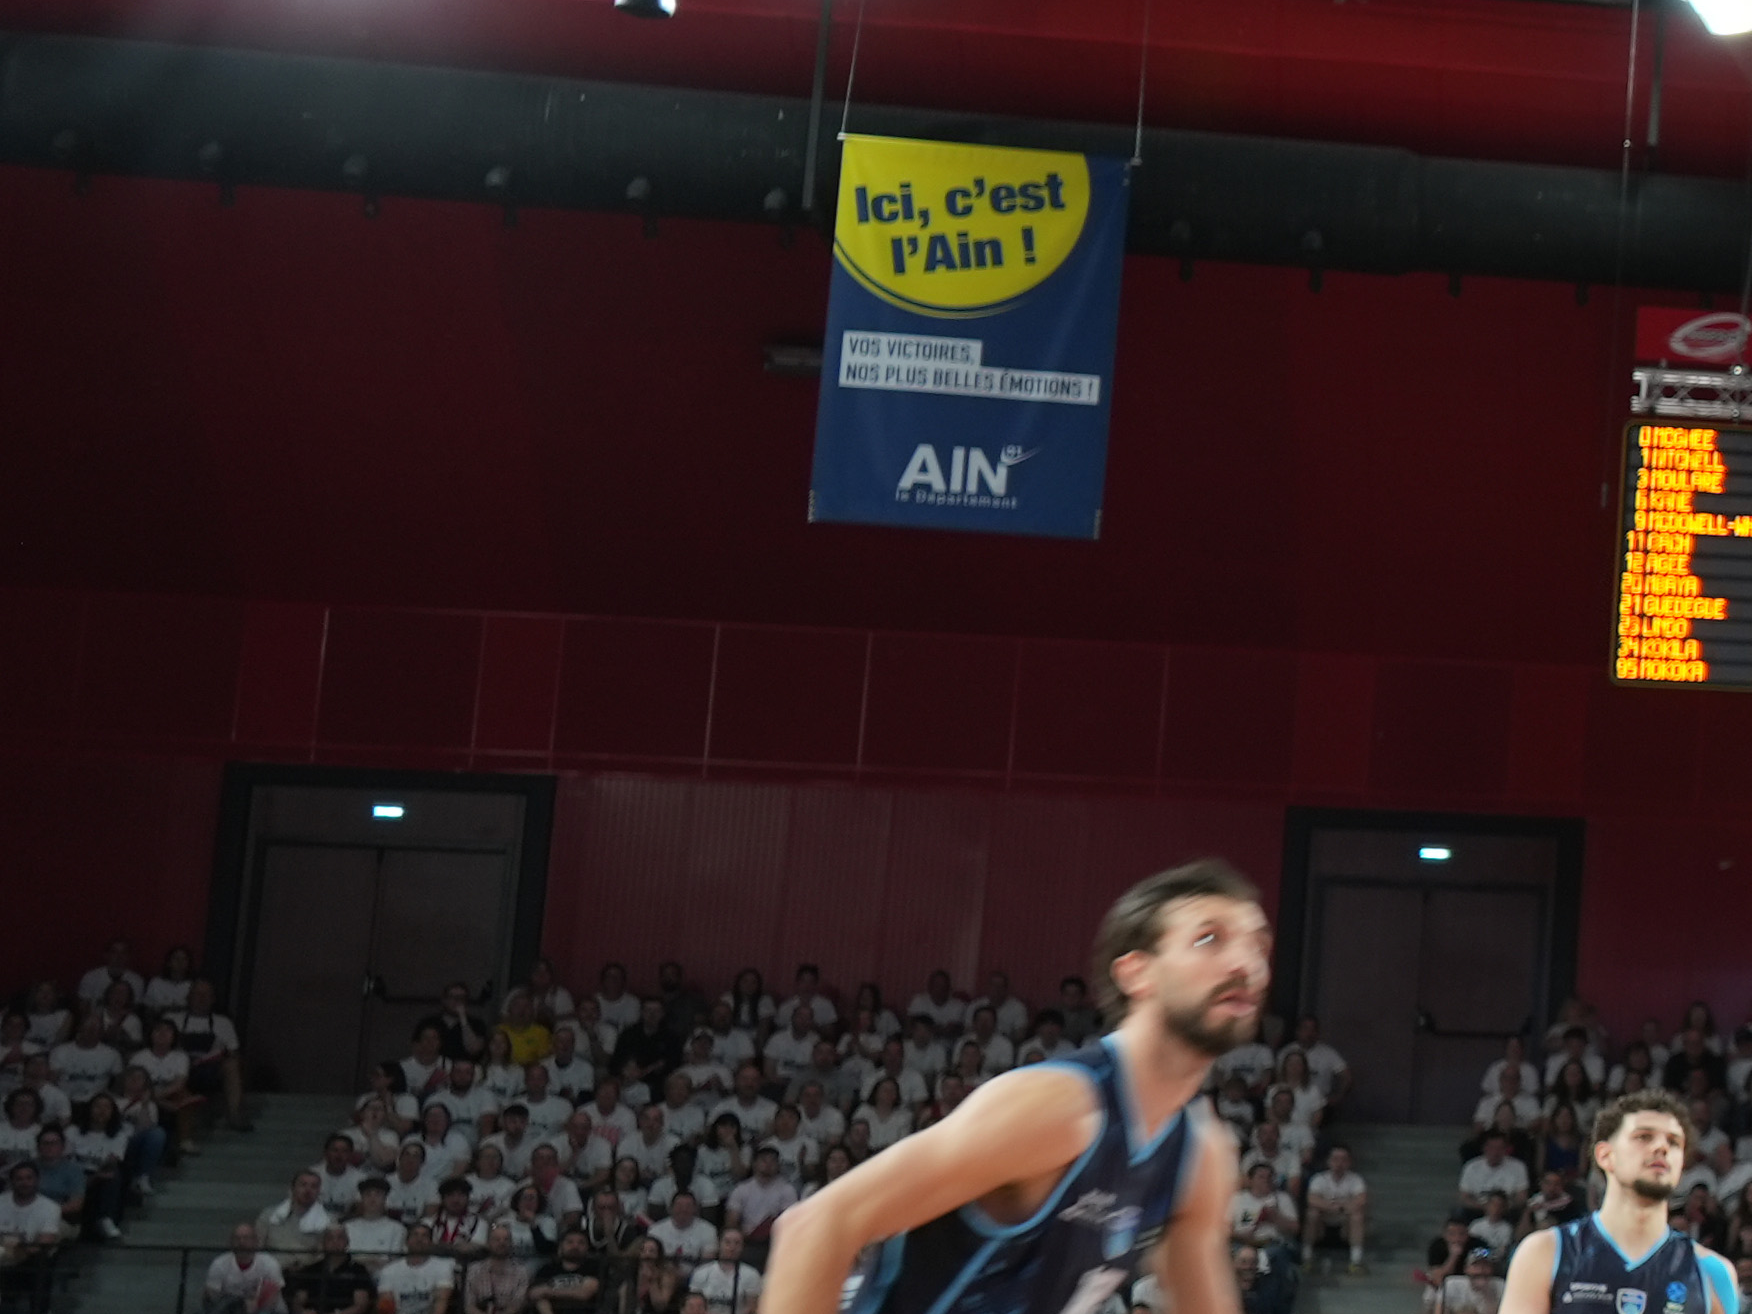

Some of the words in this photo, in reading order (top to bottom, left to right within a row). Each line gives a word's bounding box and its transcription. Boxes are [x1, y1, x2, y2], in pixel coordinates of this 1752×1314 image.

[854, 183, 930, 230] Ici,
[848, 334, 882, 359] VOS
[886, 337, 975, 364] VICTOIRES,
[845, 363, 880, 384] NOS
[885, 364, 927, 386] PLUS
[933, 367, 995, 393] BELLES
[999, 370, 1084, 400] ÉMOTIONS
[1639, 426, 1651, 447] 0
[896, 443, 1010, 497] AIN
[1626, 530, 1646, 551] 11
[1621, 572, 1644, 594] 20
[1620, 593, 1643, 615] 21
